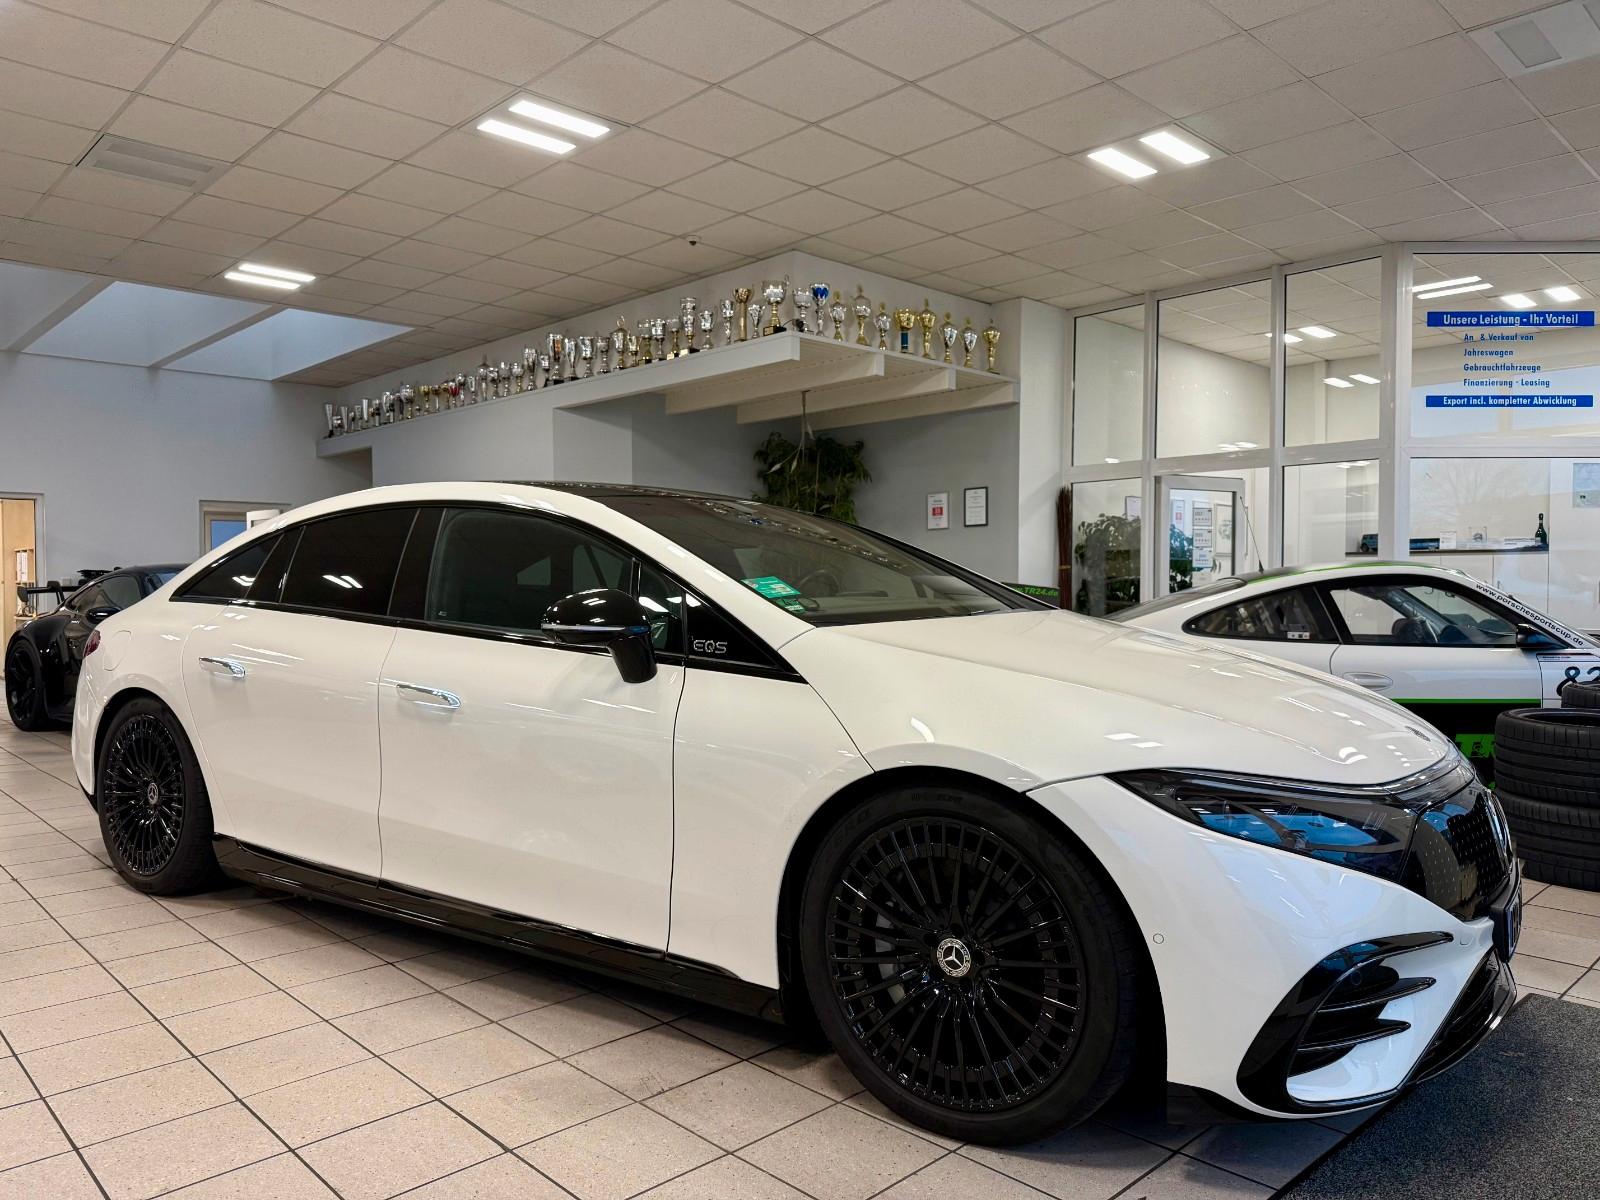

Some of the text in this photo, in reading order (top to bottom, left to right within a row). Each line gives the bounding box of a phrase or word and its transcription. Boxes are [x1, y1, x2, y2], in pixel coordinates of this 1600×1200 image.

[1443, 314, 1478, 325] Unsere
[1480, 313, 1520, 326] Leistung
[1530, 313, 1544, 324] Ihr
[1546, 313, 1579, 325] Vorteil
[1480, 333, 1486, 341] &
[1488, 333, 1518, 341] Verkauf
[1464, 349, 1514, 358] Jahreswagen
[1464, 364, 1541, 373] Gebrauchtfahrzeuge
[1464, 379, 1513, 388] Finanzierung
[1521, 379, 1550, 388] Leasing
[1443, 396, 1468, 406] Export
[1489, 396, 1531, 406] kompletter
[1533, 396, 1577, 407] Abwicklung
[1476, 583, 1584, 646] www.porschesportscup.de
[693, 640, 728, 654] EQS
